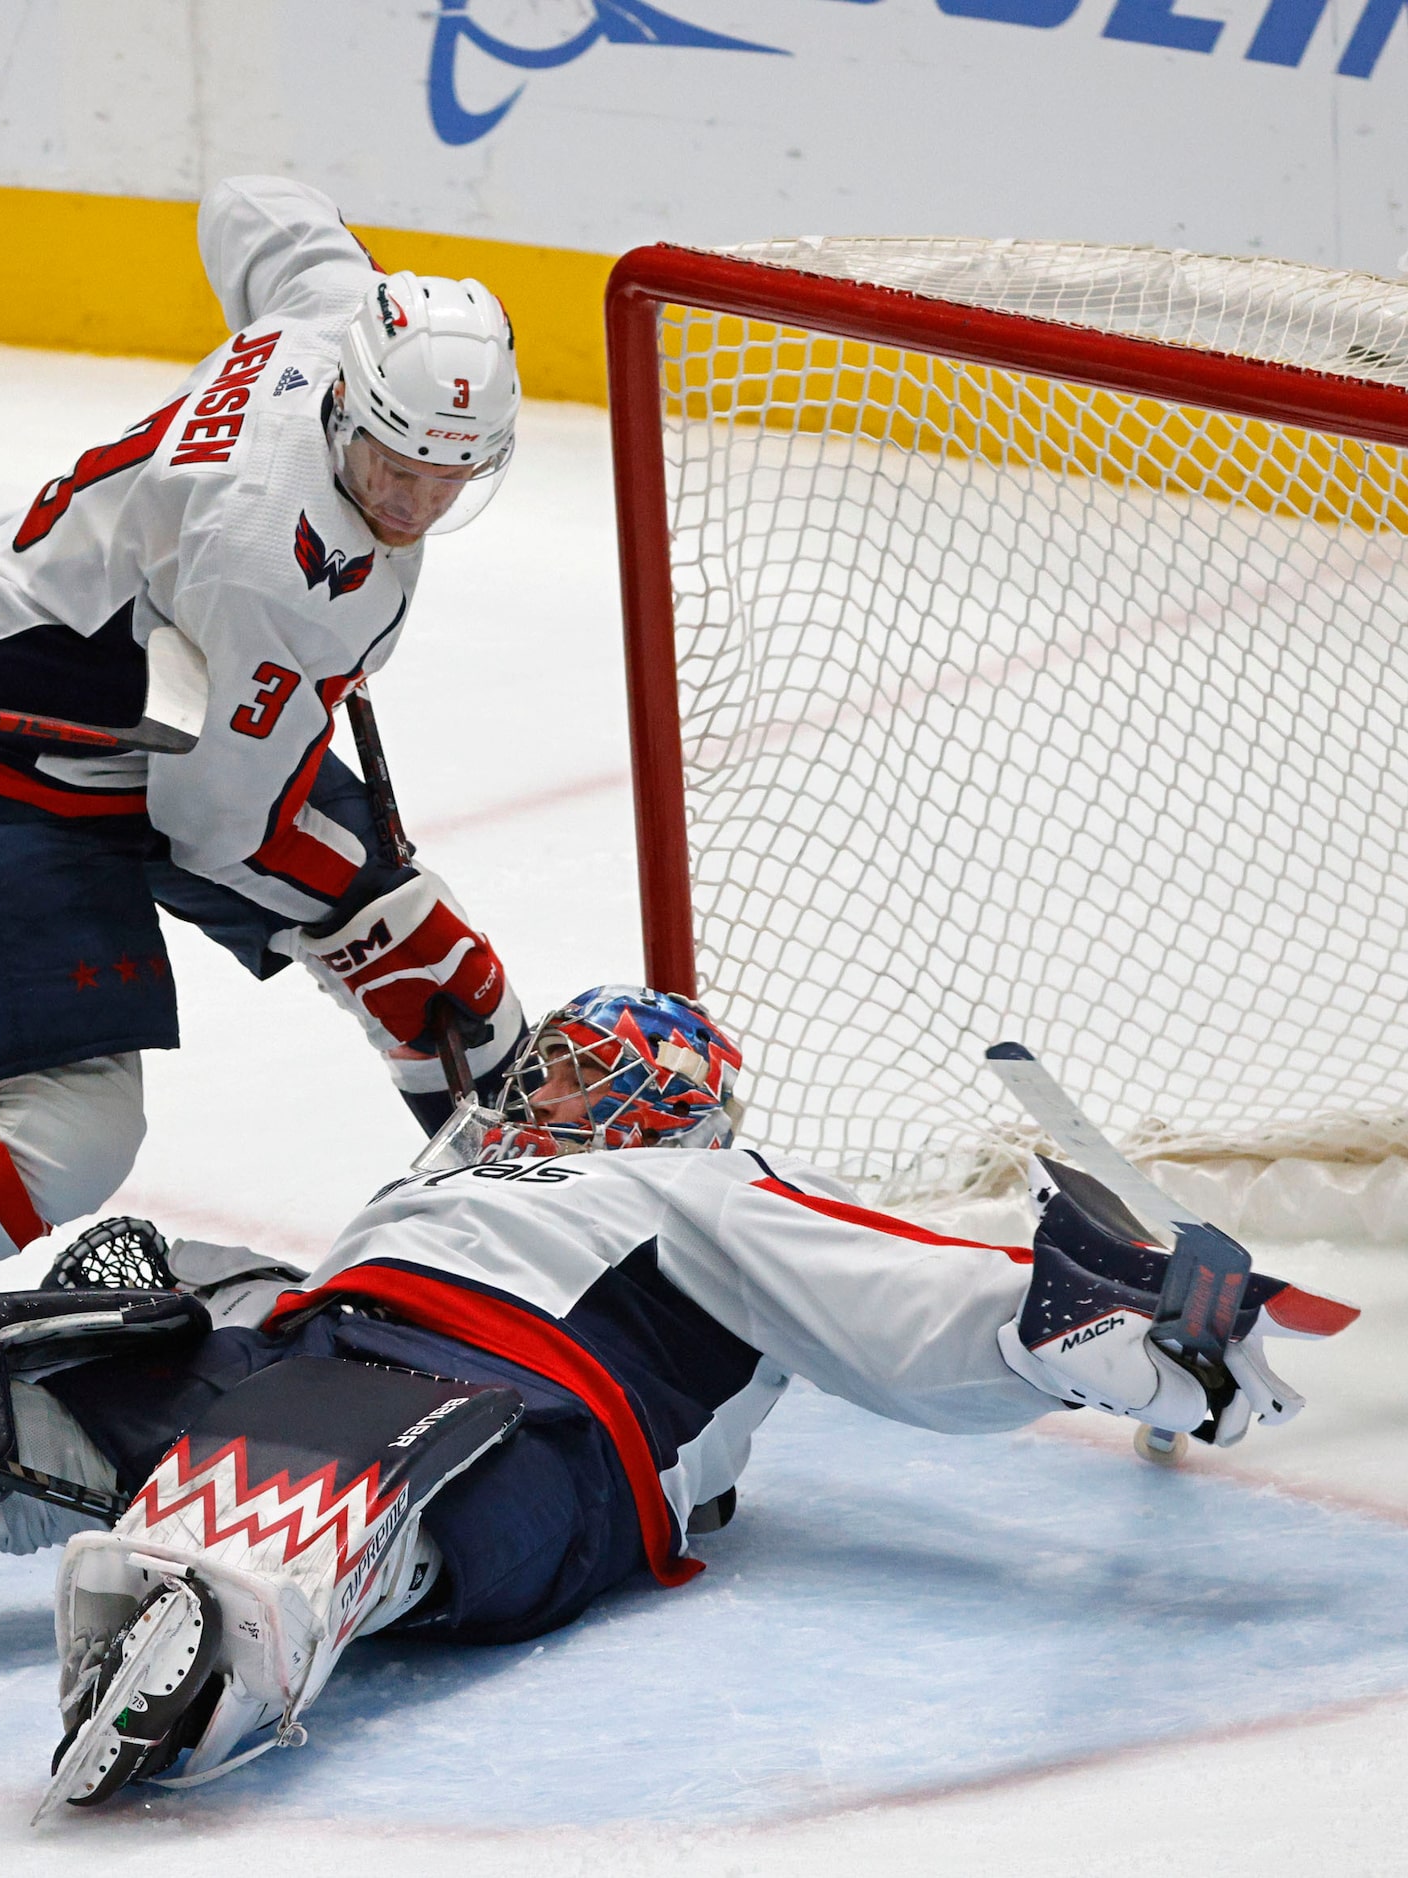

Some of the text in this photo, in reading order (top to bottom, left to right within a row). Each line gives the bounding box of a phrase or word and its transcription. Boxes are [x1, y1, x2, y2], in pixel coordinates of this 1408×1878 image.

[169, 330, 283, 467] JENSEN
[273, 366, 294, 397] adidas
[453, 378, 470, 409] 3
[425, 429, 480, 442] CCM
[230, 661, 301, 739] 3
[316, 917, 393, 973] CM
[1061, 1316, 1124, 1354] MACH
[387, 1397, 470, 1448] BAUER
[341, 1489, 407, 1616] SUPREME
